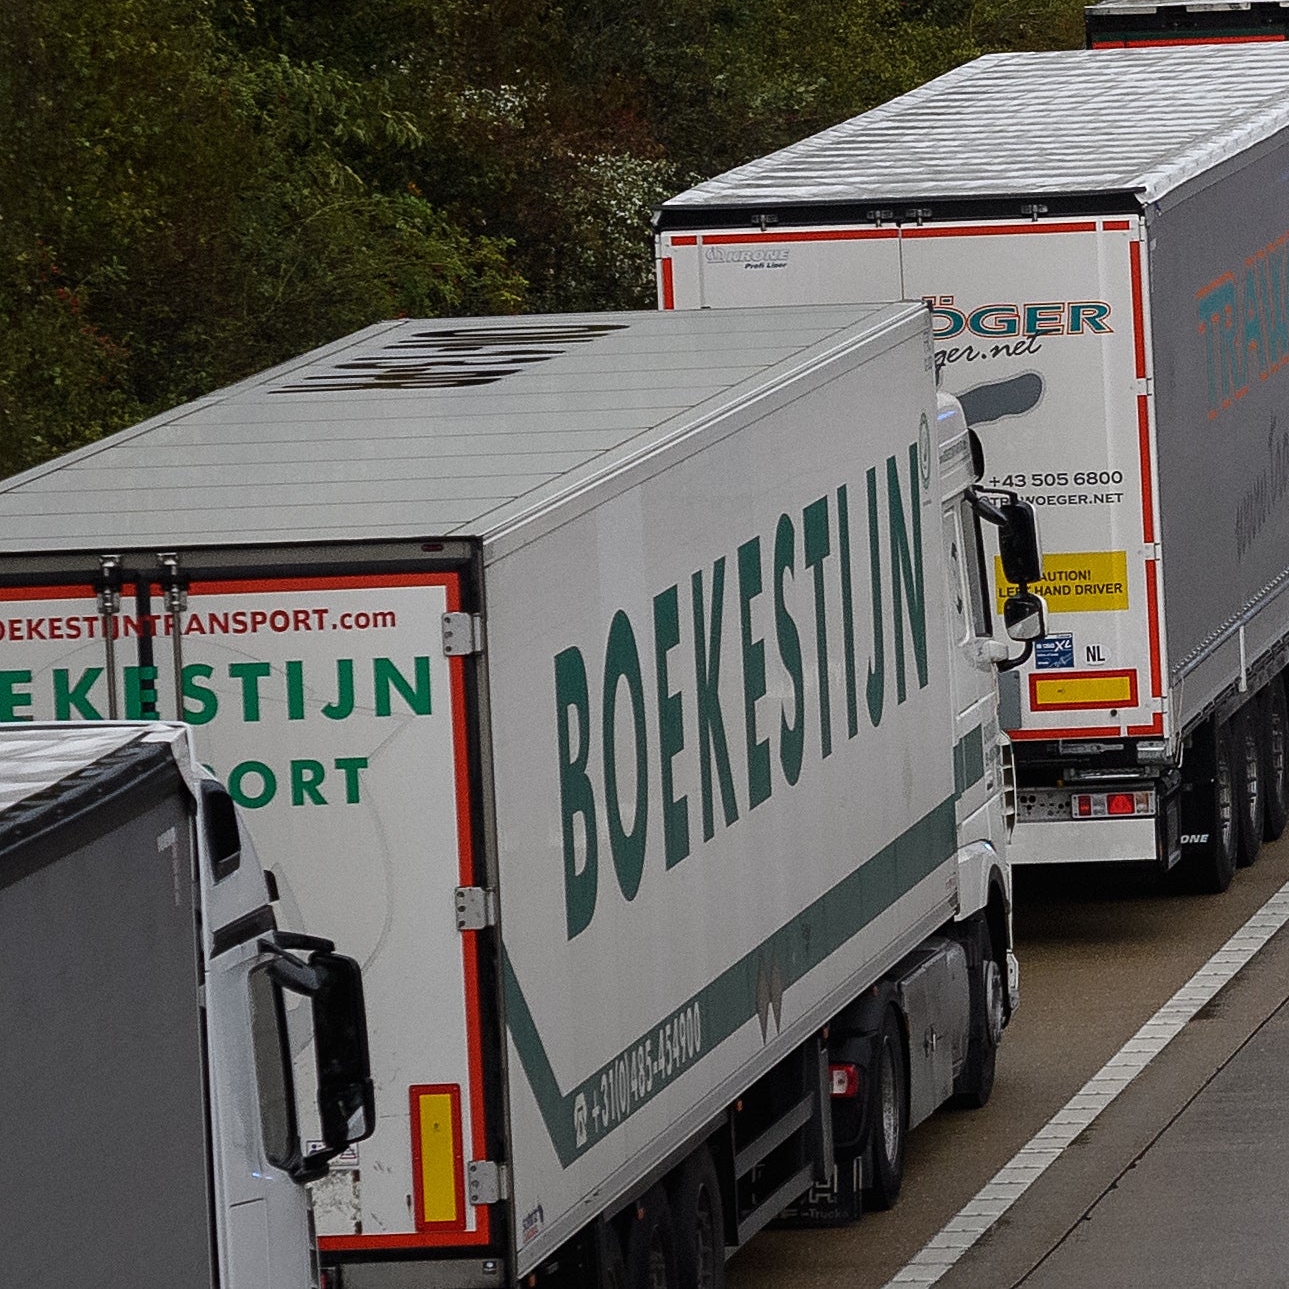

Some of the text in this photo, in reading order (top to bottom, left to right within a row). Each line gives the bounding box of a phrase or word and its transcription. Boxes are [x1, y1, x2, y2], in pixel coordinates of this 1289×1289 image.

[922, 295, 1115, 341] ÖGER
[934, 328, 1061, 387] ger.net
[989, 471, 1123, 488] +43 505 6800
[1034, 585, 1071, 597] HAND
[1075, 582, 1123, 595] DRIVER
[1037, 570, 1091, 582] AUTION!
[1086, 645, 1106, 662] NL
[0, 655, 433, 726] EKESTIJN
[553, 441, 929, 942] BOEKESTIJN
[228, 756, 369, 810] ORT
[1180, 834, 1210, 844] ONE
